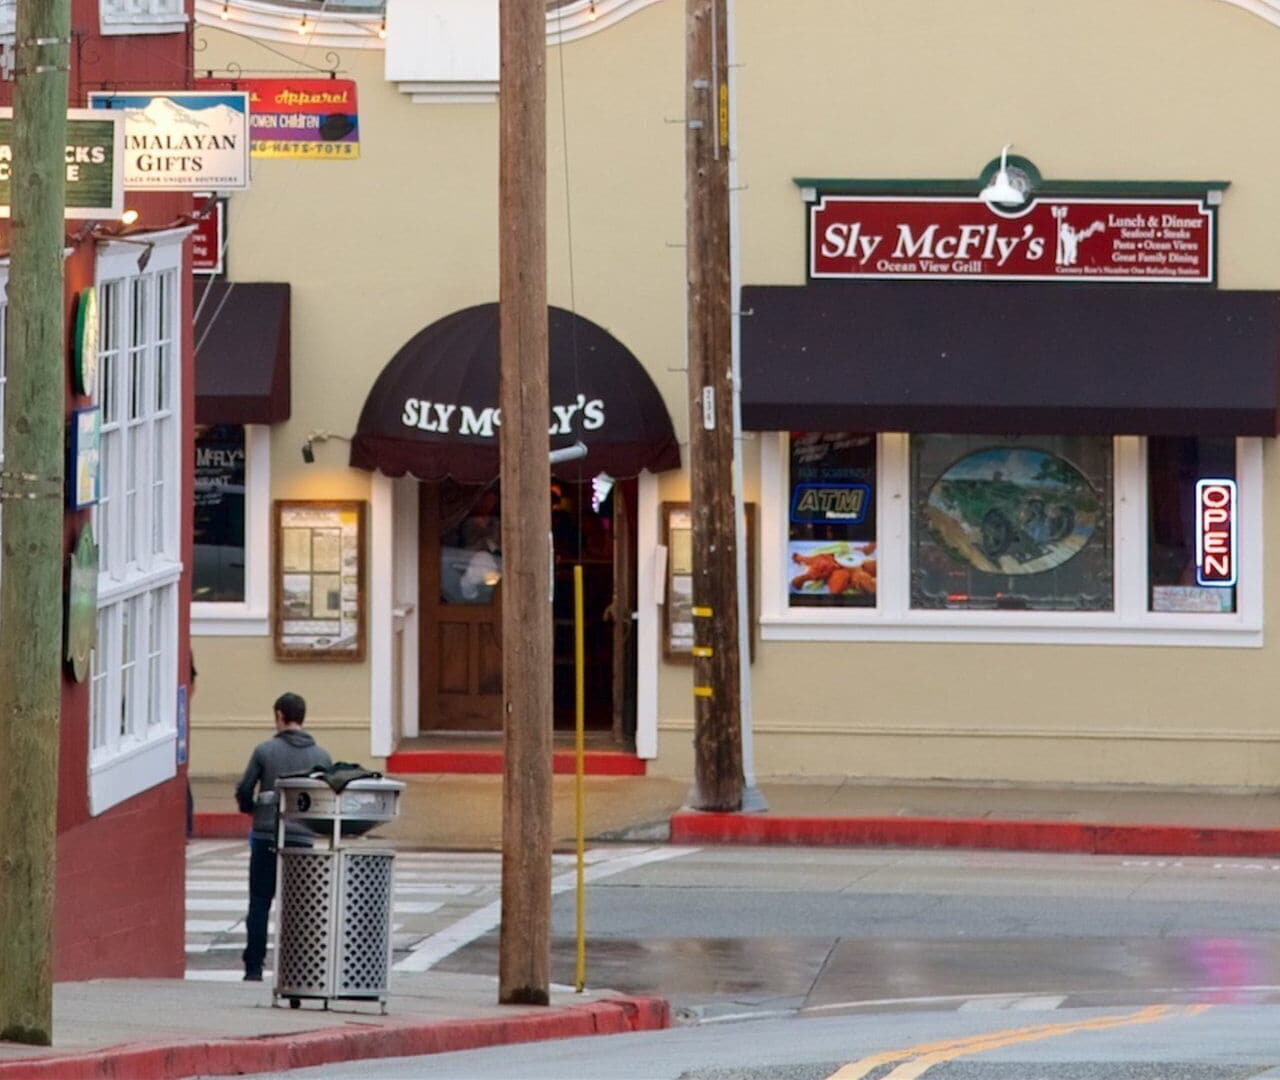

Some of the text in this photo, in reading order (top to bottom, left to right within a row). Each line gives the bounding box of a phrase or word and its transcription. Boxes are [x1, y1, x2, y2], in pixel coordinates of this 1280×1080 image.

[275, 90, 348, 105] Apparel
[124, 135, 237, 151] IMALAYAN
[137, 154, 203, 172] GIFTS
[1108, 214, 1204, 228] Lunch & Dinner
[822, 222, 1045, 266] Sly McFly's
[877, 260, 982, 273] Ocean View Grill
[1138, 252, 1167, 264] Family
[1168, 252, 1199, 265] Dining
[402, 398, 457, 433] SLY
[798, 488, 865, 511] ATM
[1203, 486, 1230, 576] OPEN
